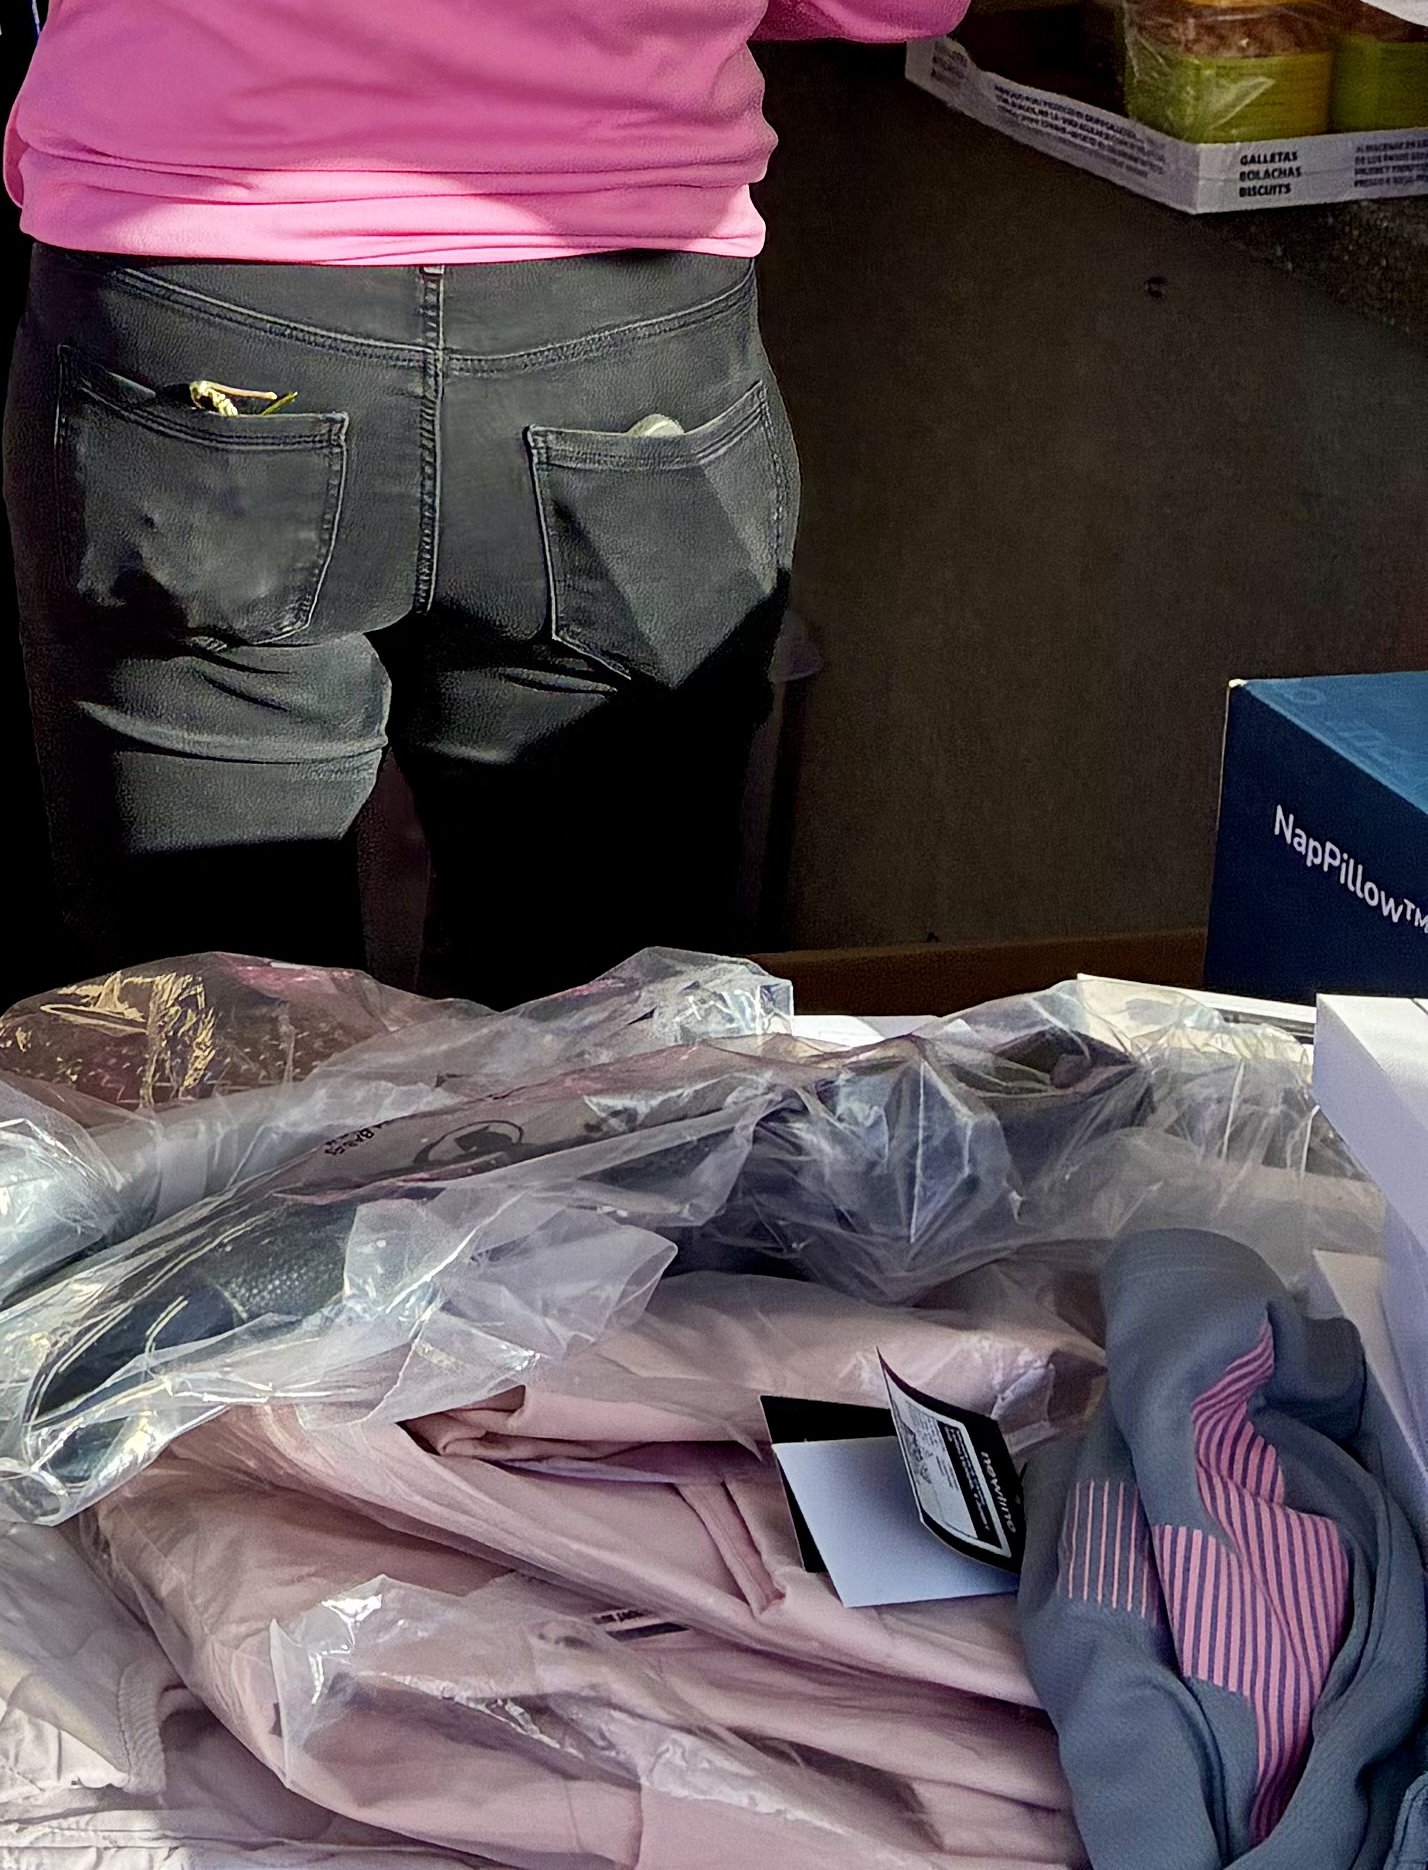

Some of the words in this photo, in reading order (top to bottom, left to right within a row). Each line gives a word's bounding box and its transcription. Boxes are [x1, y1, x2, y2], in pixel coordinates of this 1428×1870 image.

[1240, 151, 1298, 166] GALLETAS
[1239, 166, 1302, 182] BOLACHAS
[1239, 183, 1291, 197] BISCUITS
